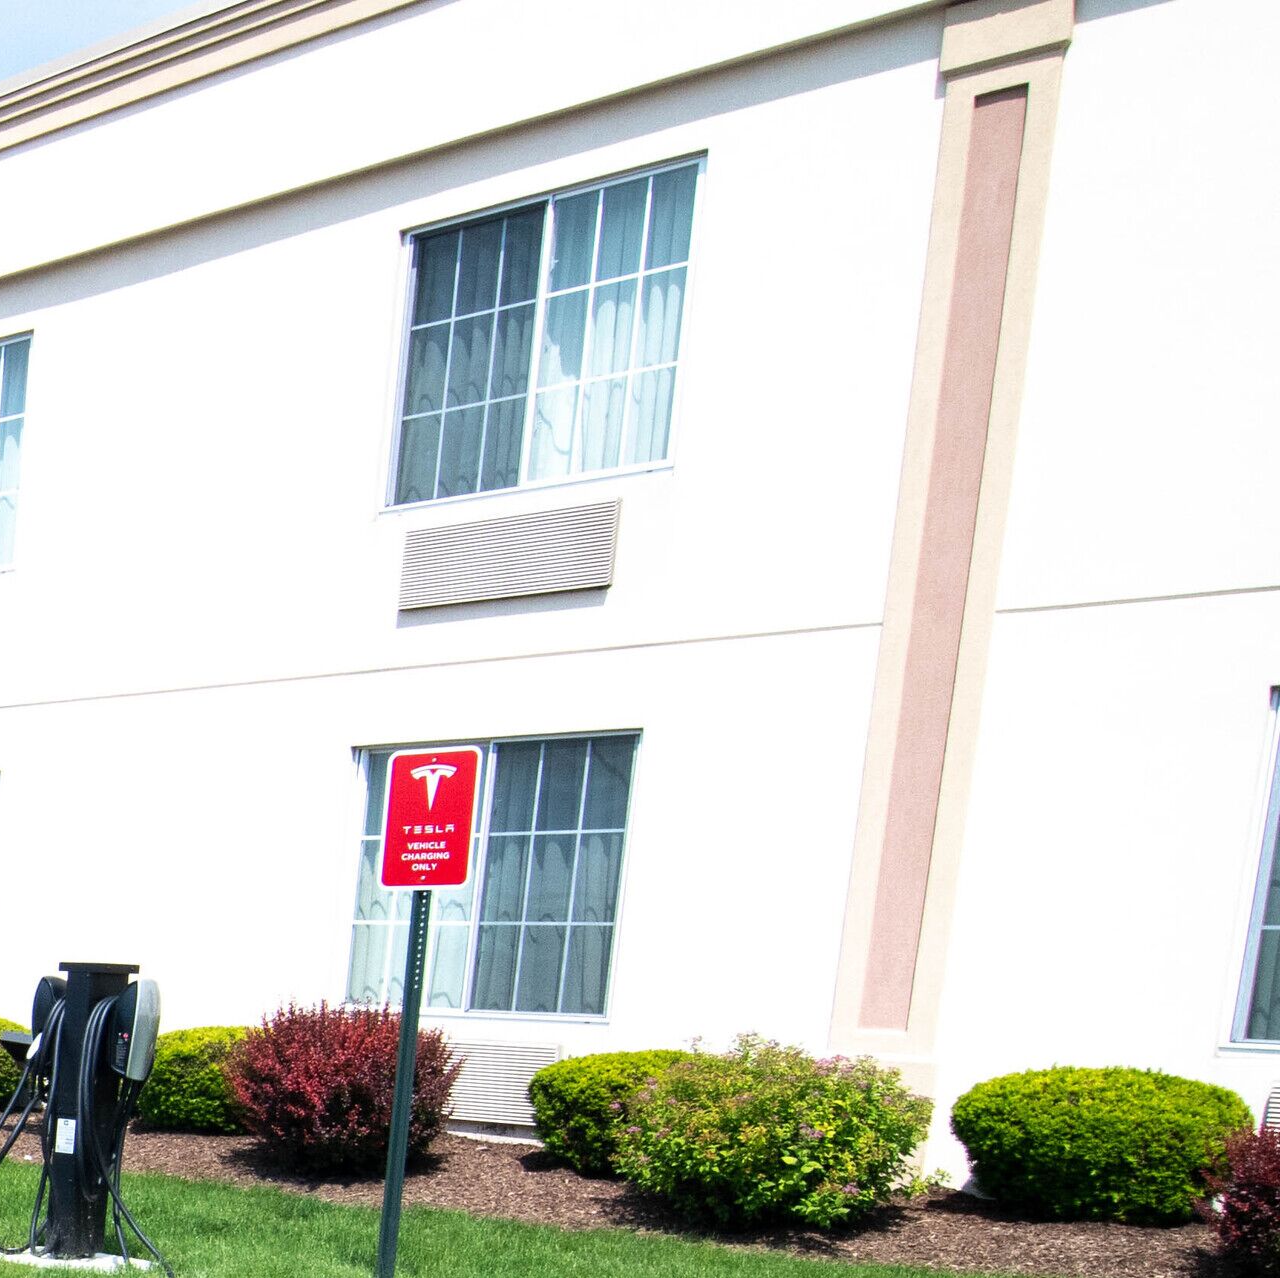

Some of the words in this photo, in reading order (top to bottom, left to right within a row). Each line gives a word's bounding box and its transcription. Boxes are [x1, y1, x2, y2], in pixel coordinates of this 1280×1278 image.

[402, 824, 455, 834] TESLA
[407, 841, 446, 850] VEHICLE
[401, 851, 450, 861] CHARGING
[411, 862, 438, 871] ONLY
